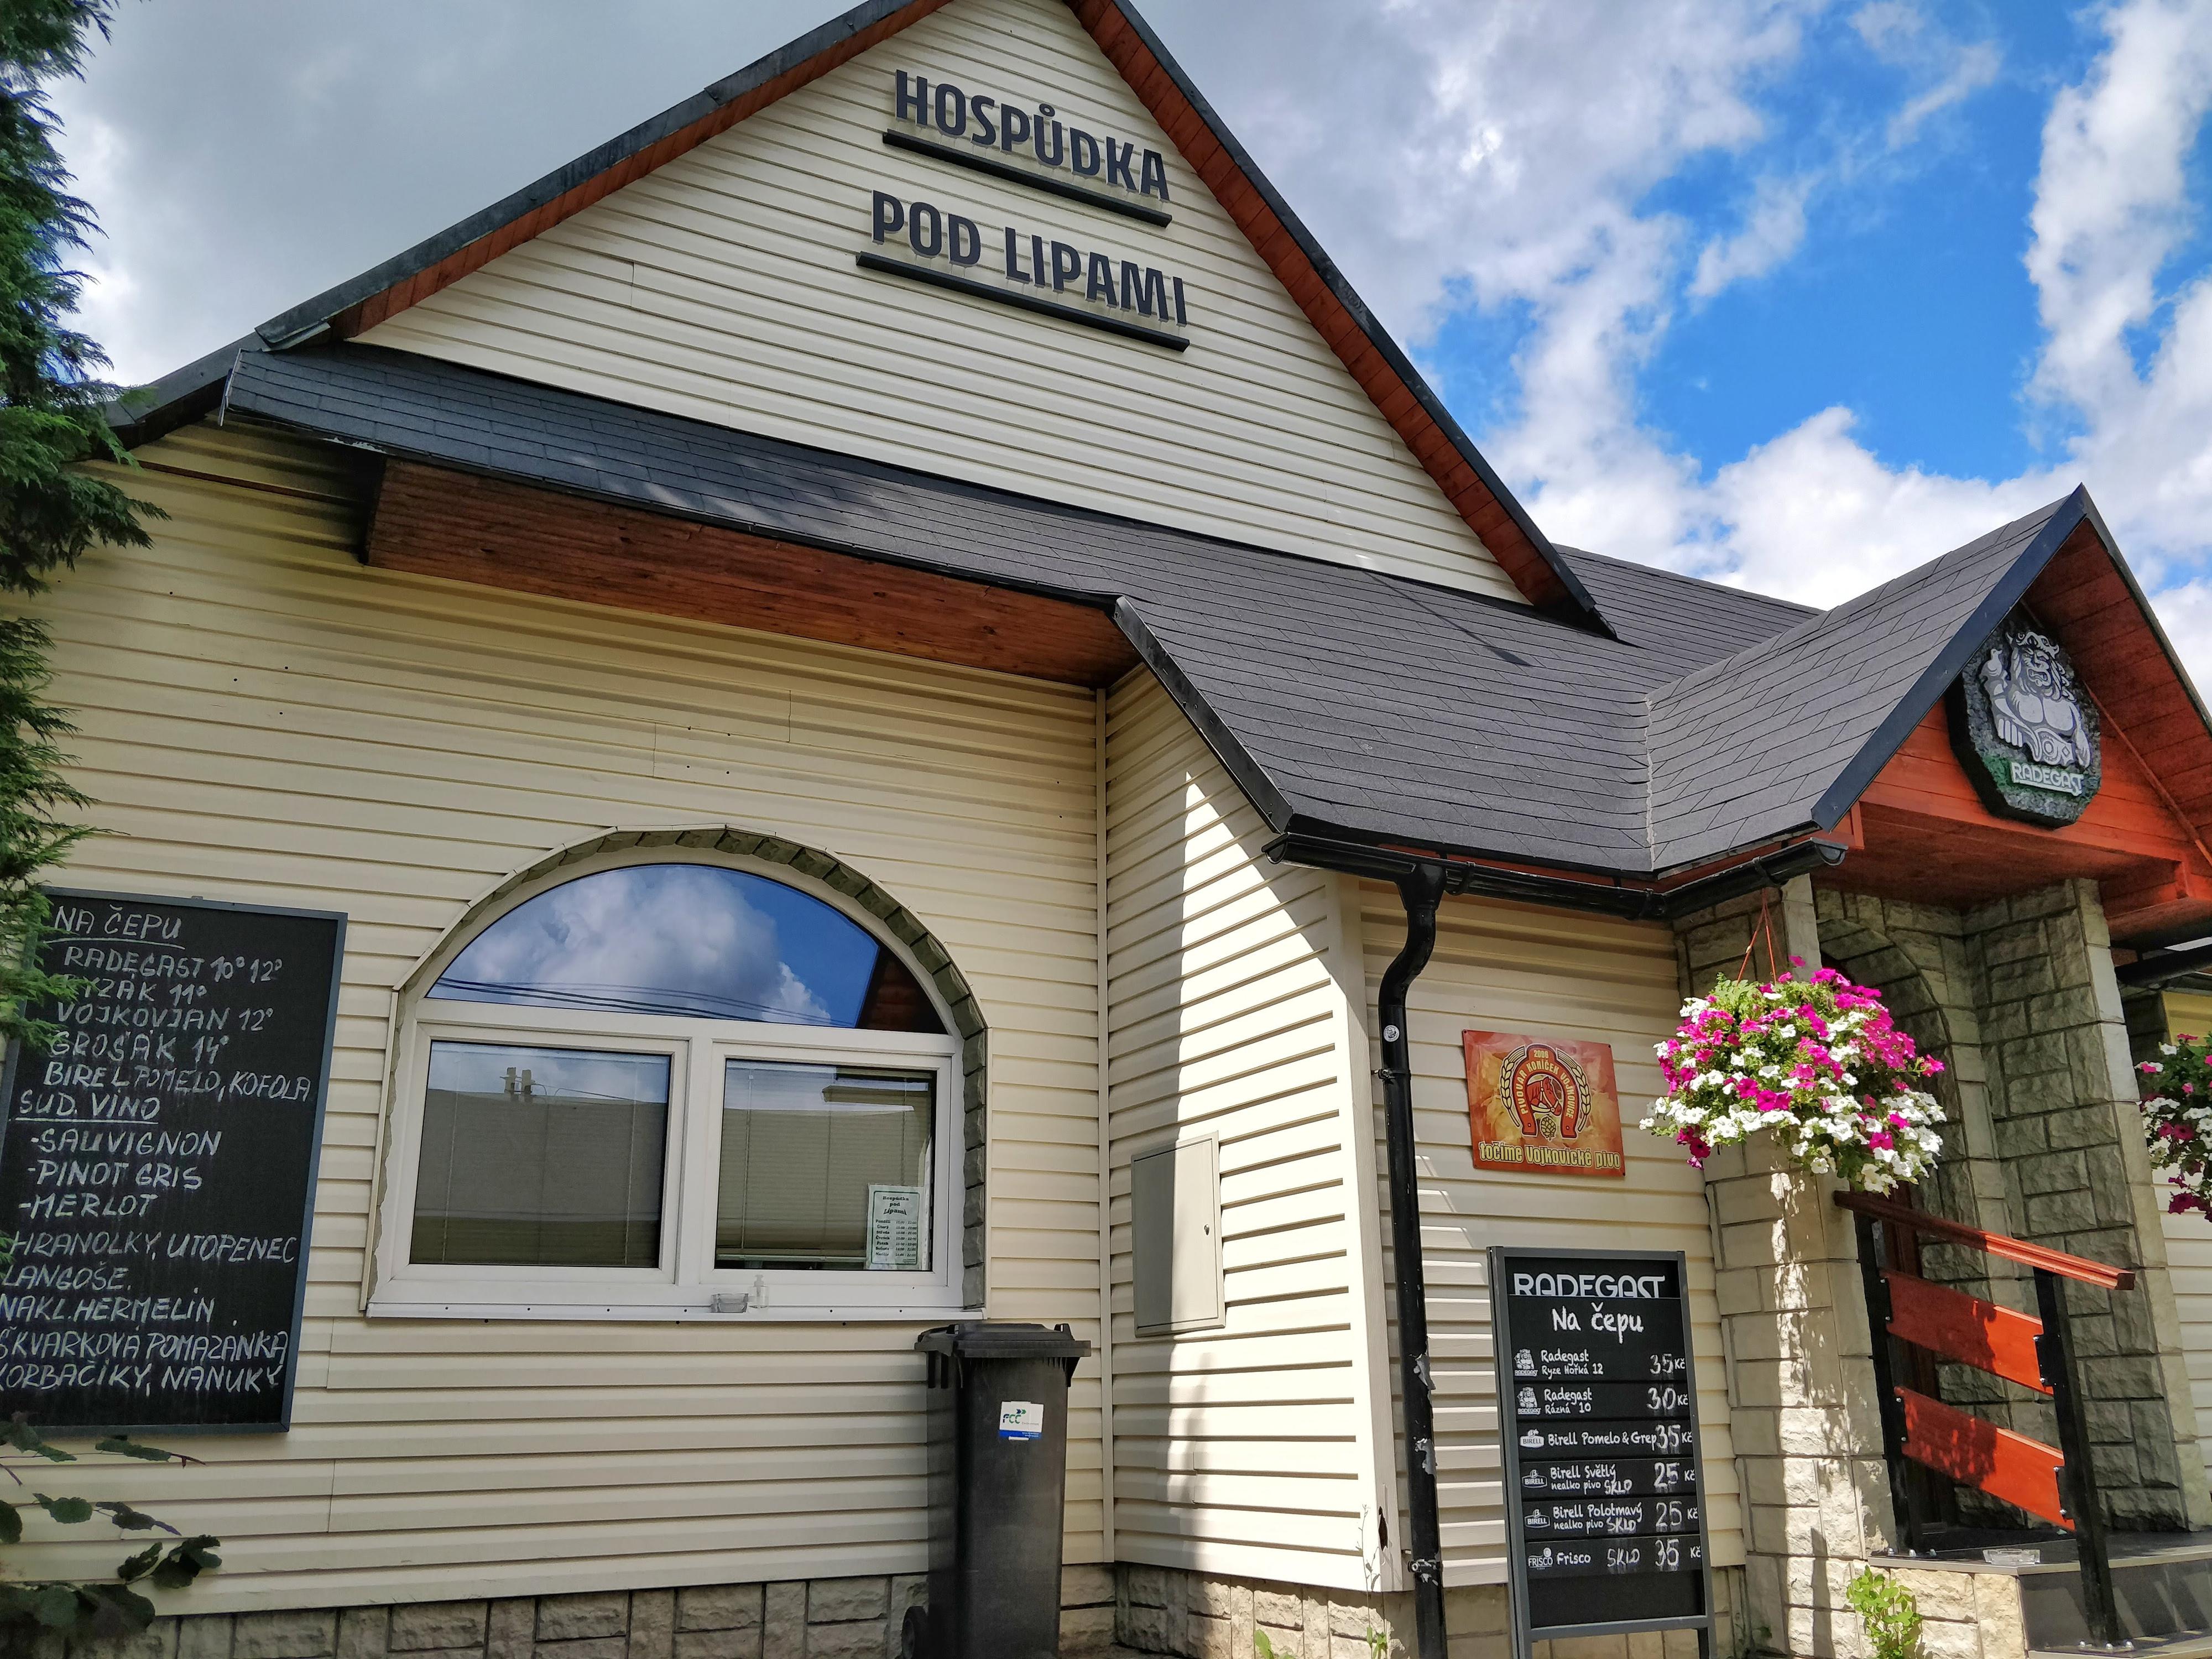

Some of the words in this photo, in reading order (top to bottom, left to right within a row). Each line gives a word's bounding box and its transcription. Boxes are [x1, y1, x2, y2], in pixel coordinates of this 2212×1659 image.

[895, 69, 1170, 202] HOSPŮDKA
[871, 189, 981, 267] POD
[1004, 226, 1187, 327] LIPAMI
[2011, 762, 2084, 796] RADEGAST
[55, 905, 95, 934] NA
[105, 904, 181, 940] ČEPU
[64, 947, 205, 978] RADEGAST
[58, 1001, 231, 1031] VOJKOVJAN
[44, 1061, 130, 1088] BIREL
[229, 1070, 311, 1102] KOFOLA
[1516, 1070, 1528, 1115] PIVOVAR
[19, 1089, 79, 1115] SUD.
[1595, 1151, 1621, 1168] pivo
[135, 1163, 203, 1190] GRIS
[167, 1233, 296, 1264] UTOPENEC
[1514, 1273, 1665, 1298] RADEGAST
[1552, 1306, 1581, 1332] Na
[1590, 1302, 1644, 1344] čepu
[1541, 1348, 1589, 1366] Radegast
[1542, 1365, 1561, 1380] Ryze
[1564, 1364, 1589, 1375] Hořká
[1593, 1363, 1604, 1374] 12
[1650, 1354, 1673, 1374] 35
[1674, 1358, 1686, 1369] Kč
[161, 1364, 283, 1394] NANUKY
[1544, 1386, 1593, 1405] Radegast
[1545, 1404, 1571, 1414] Rázná
[1579, 1402, 1592, 1413] 10
[1646, 1387, 1676, 1410] 30
[1677, 1394, 1688, 1406] Kč
[1003, 1413, 1021, 1424] FCC
[1548, 1432, 1578, 1447] Birell
[1582, 1431, 1620, 1446] Pomelo
[1621, 1432, 1630, 1444] &
[1631, 1431, 1657, 1451] Grep
[1655, 1424, 1681, 1449] 35
[1681, 1432, 1693, 1444] Kč
[1550, 1464, 1580, 1479] Birell
[1585, 1464, 1616, 1482] Světlý
[1653, 1462, 1680, 1488] 25
[1684, 1469, 1695, 1481] Kč
[1551, 1480, 1580, 1490] nealko
[1584, 1480, 1601, 1495] pivo
[1527, 1517, 1547, 1526] BIRELL
[1553, 1504, 1583, 1519] Birell
[1587, 1501, 1642, 1522] Polotmavý
[1655, 1501, 1682, 1527] 25
[1687, 1508, 1699, 1520] Kč
[1553, 1519, 1583, 1530] nealko
[1586, 1520, 1604, 1535] pivo
[1528, 1557, 1553, 1567] FRISCO
[1557, 1552, 1591, 1566] Frisco
[1655, 1538, 1679, 1567] 35
[1690, 1547, 1701, 1559] Kč
